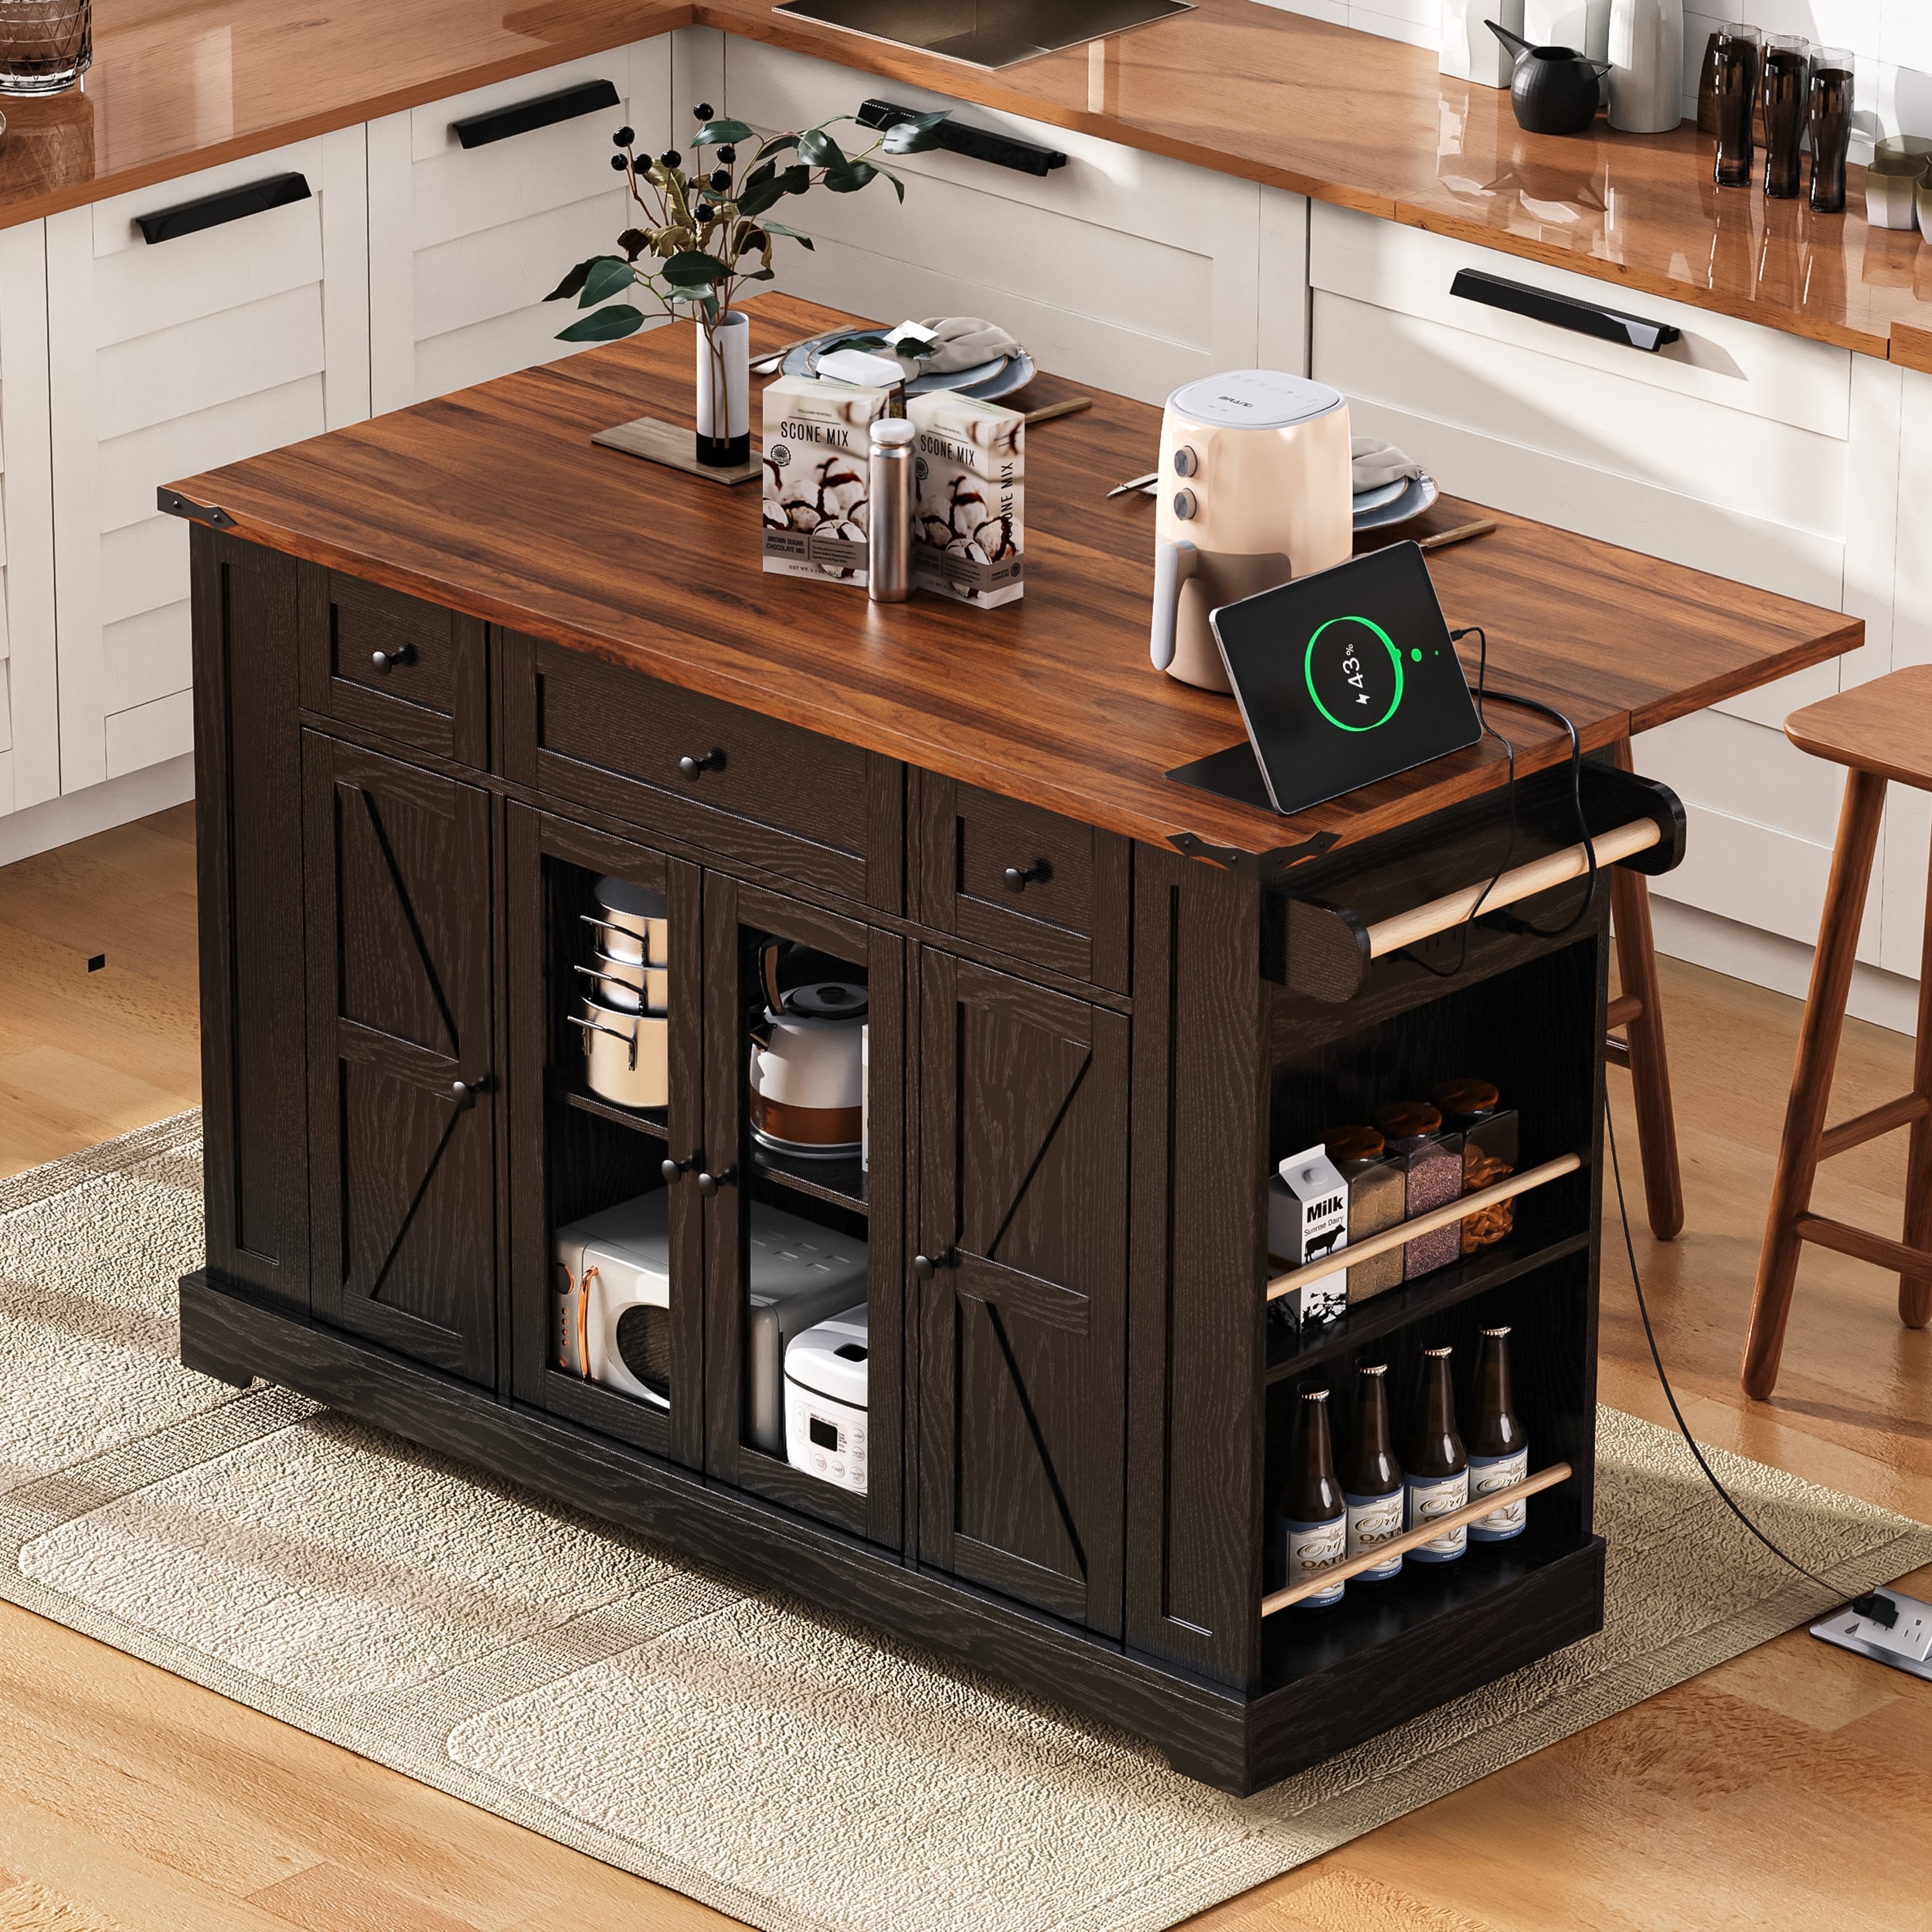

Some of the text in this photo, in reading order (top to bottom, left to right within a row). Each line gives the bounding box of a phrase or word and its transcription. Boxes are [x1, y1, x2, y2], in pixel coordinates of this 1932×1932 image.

[781, 421, 849, 447] SCONE MIX
[920, 434, 975, 468] SCONE MIX
[1001, 462, 1013, 489] MIX
[766, 543, 795, 553] CHOCOLATE
[767, 535, 804, 547] BROWN SUGAR
[1307, 1196, 1343, 1223] Milk
[1304, 1216, 1344, 1236] Sunrise Dairy
